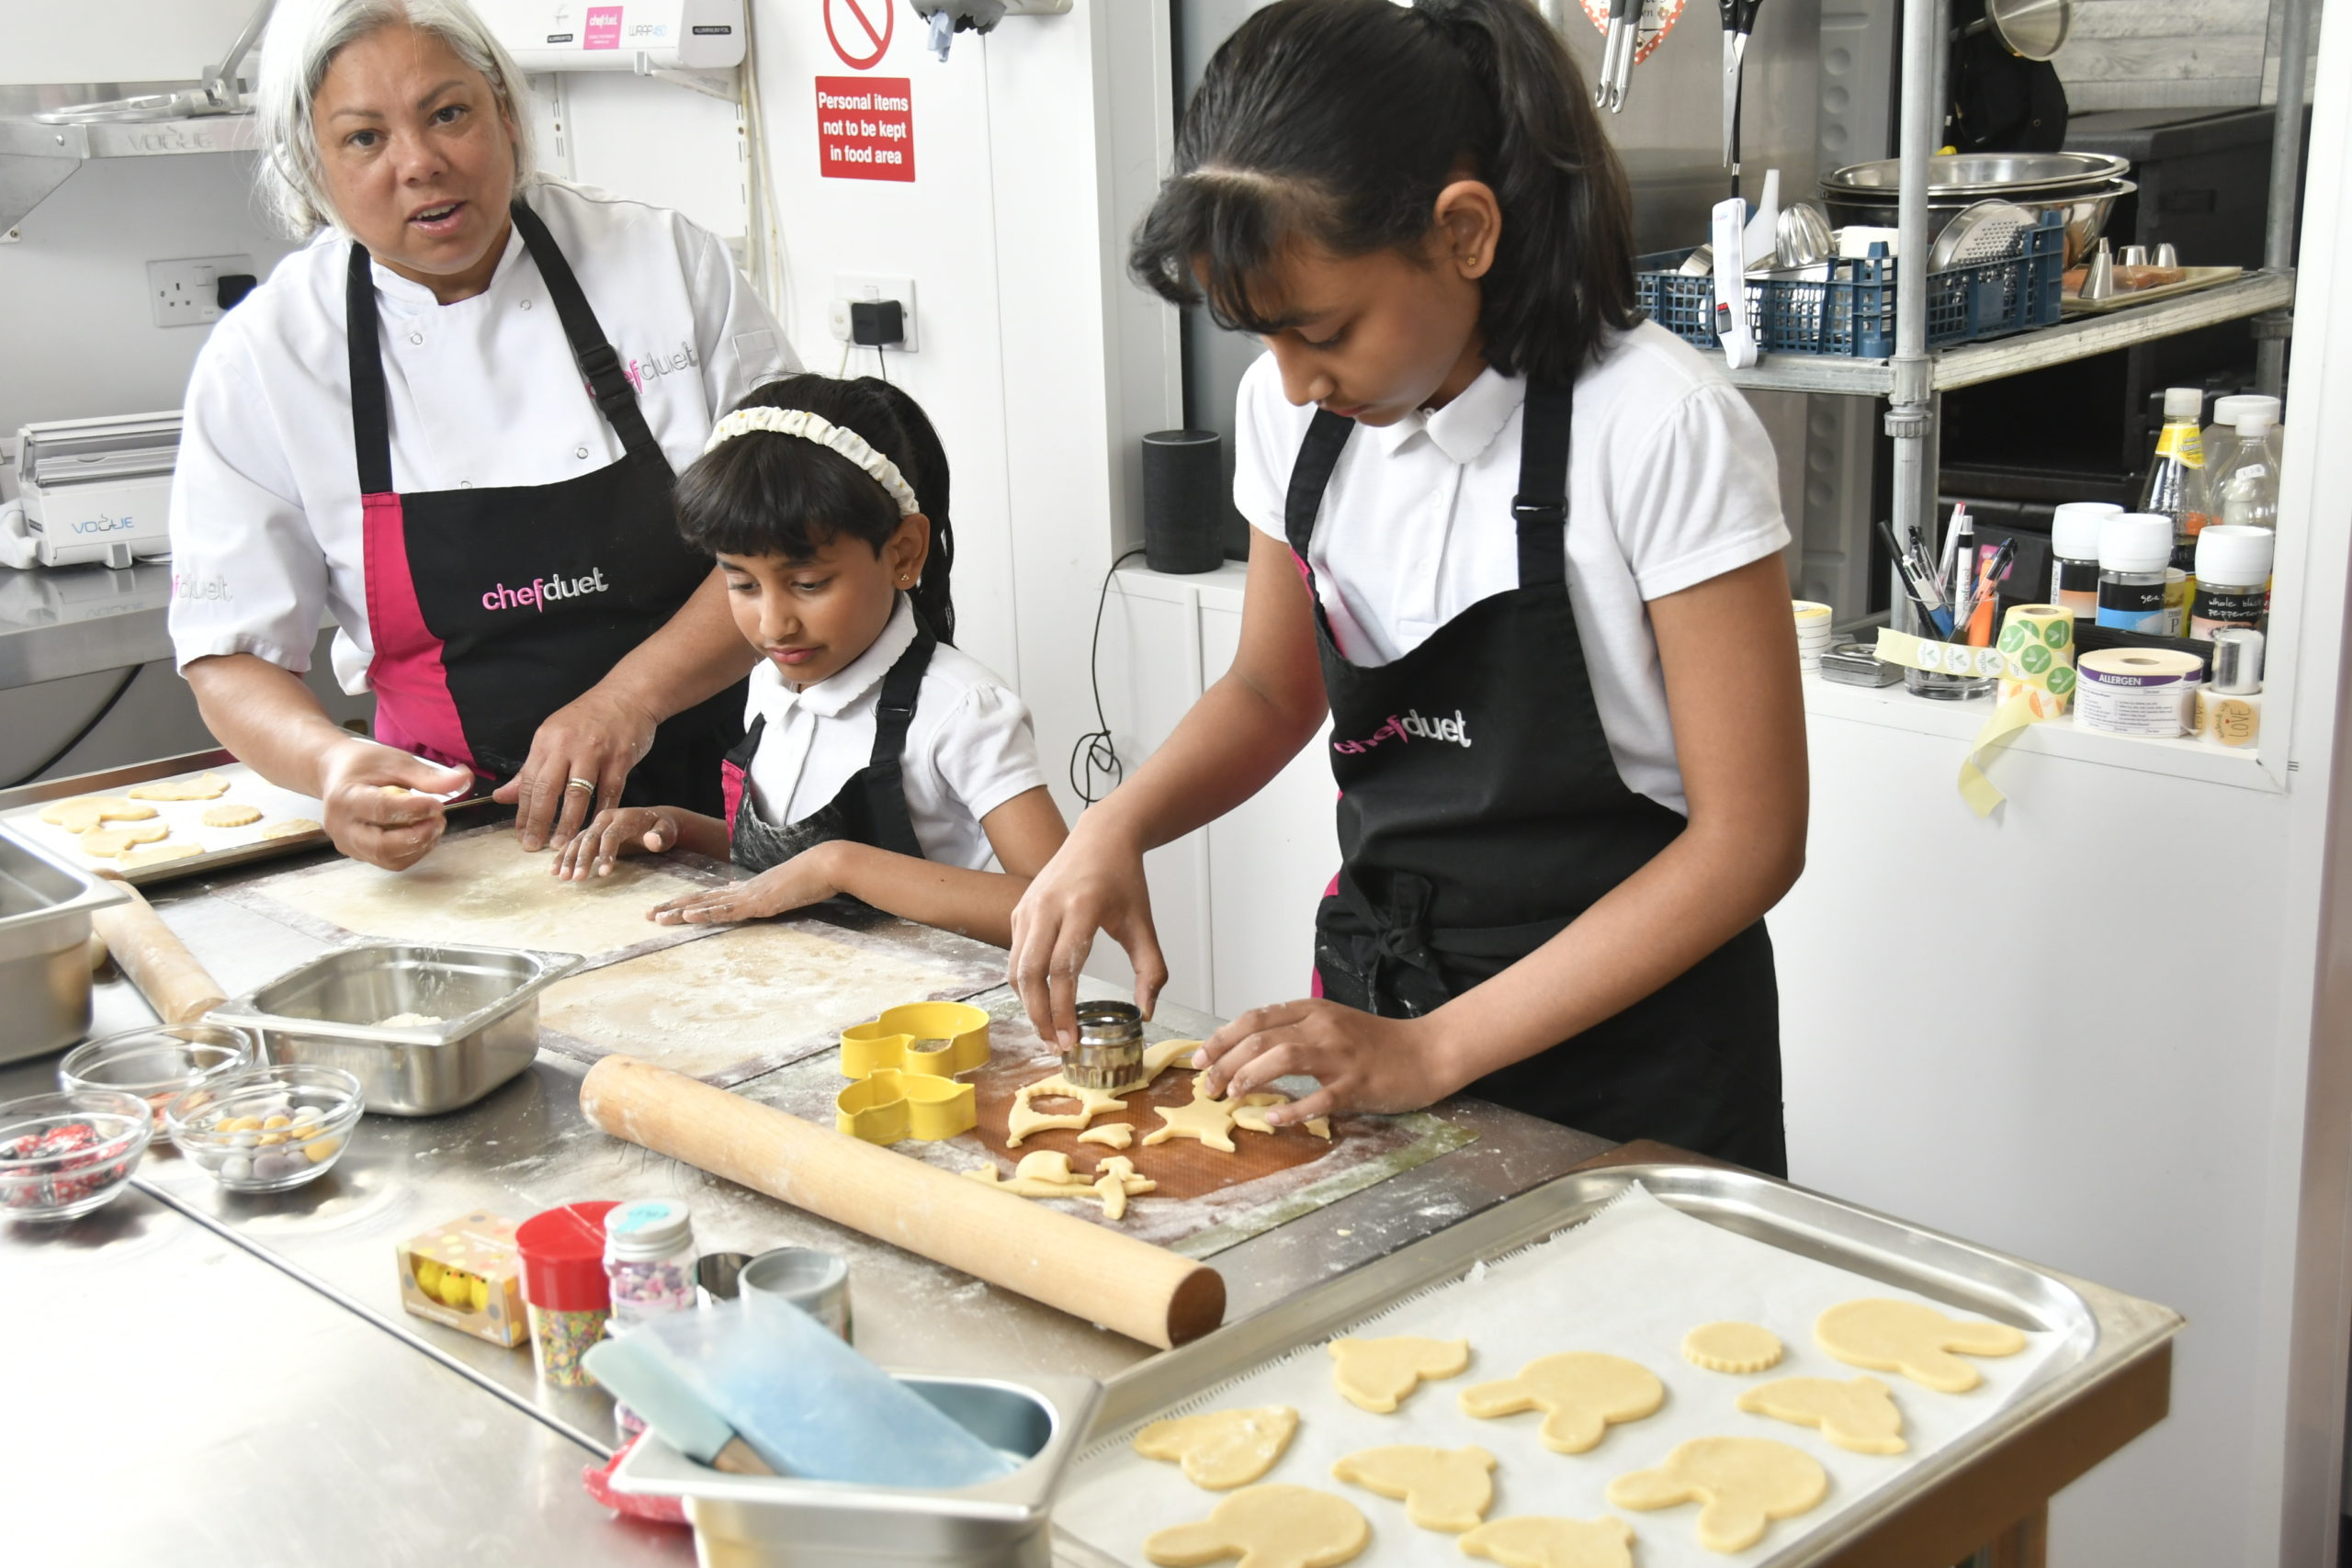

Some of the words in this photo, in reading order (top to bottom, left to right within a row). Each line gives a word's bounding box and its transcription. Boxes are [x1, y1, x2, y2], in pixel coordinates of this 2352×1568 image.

[818, 91, 871, 110] Personal
[874, 93, 909, 111] items
[823, 119, 843, 136] not
[845, 119, 858, 136] to
[860, 119, 876, 137] be
[878, 119, 907, 142] kept
[830, 144, 842, 162] in
[844, 144, 872, 163] food
[875, 150, 902, 164] area
[482, 567, 609, 613] chefduet
[2208, 597, 2236, 608] whole
[2098, 673, 2142, 686] ALLERGEN
[2231, 705, 2251, 739] LOVE
